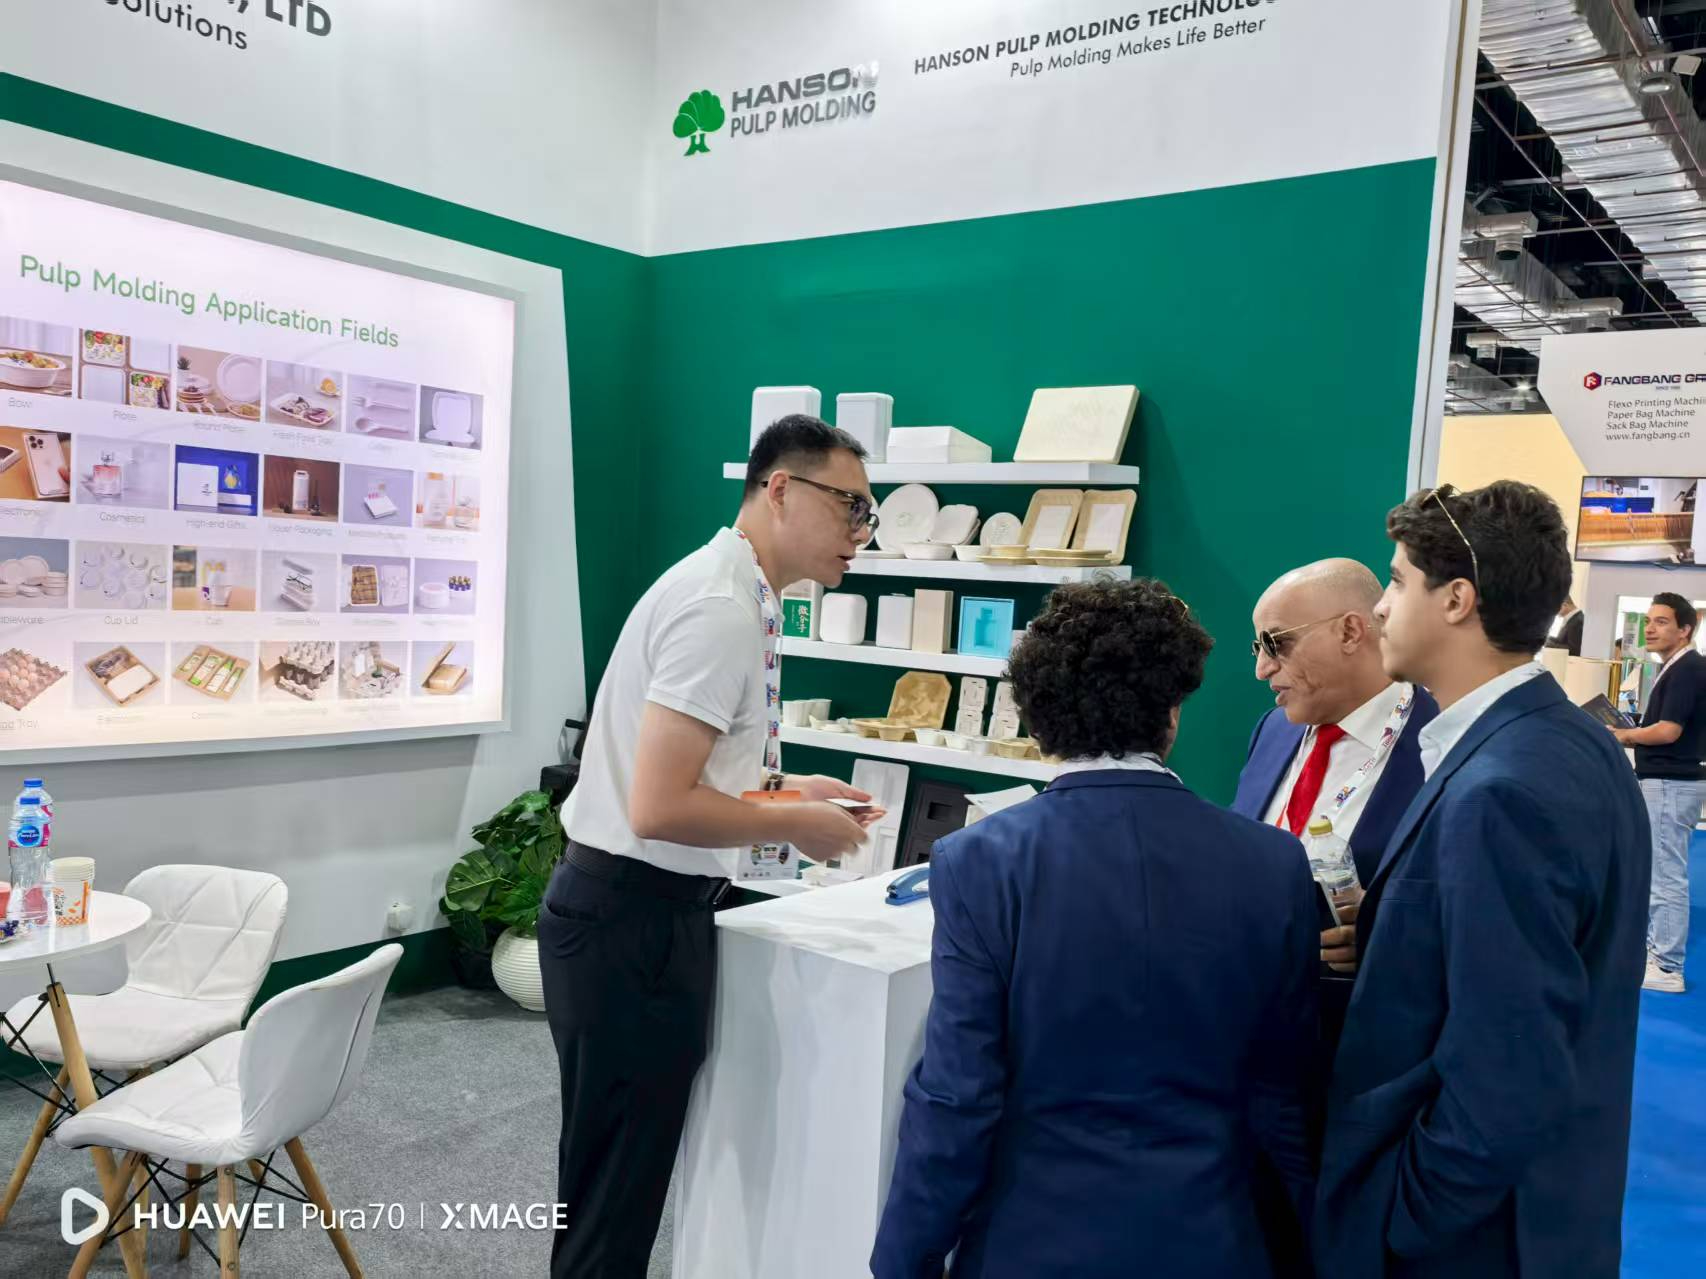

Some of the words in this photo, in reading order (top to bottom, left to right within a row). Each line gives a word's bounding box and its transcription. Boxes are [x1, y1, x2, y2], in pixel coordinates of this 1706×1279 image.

[105, 0, 247, 50] olutions
[914, 44, 990, 75] HANSON
[995, 34, 1041, 58] PULP
[1045, 13, 1140, 48] MOLDING
[1010, 58, 1043, 78] Pulp
[1047, 48, 1112, 71] Molding
[1117, 36, 1171, 58] Makes
[1177, 26, 1207, 46] Life
[1213, 19, 1266, 39] Better
[730, 109, 777, 138] PULP
[782, 91, 877, 128] MOLDING
[20, 254, 82, 293] Pulp
[92, 269, 196, 315] Molding
[205, 292, 332, 336] Application
[340, 319, 400, 348] Fields
[1604, 374, 1681, 385] FANGBANG
[1607, 411, 1634, 420] Paper
[1635, 410, 1653, 420] Bag
[1656, 408, 1696, 417] Machine
[1608, 400, 1632, 409] Flexo
[1634, 398, 1672, 408] Printing
[1606, 421, 1628, 430] Sack
[1629, 421, 1647, 431] Bag
[1649, 419, 1689, 429] Machine
[1606, 431, 1691, 441] www.fangbang.cn
